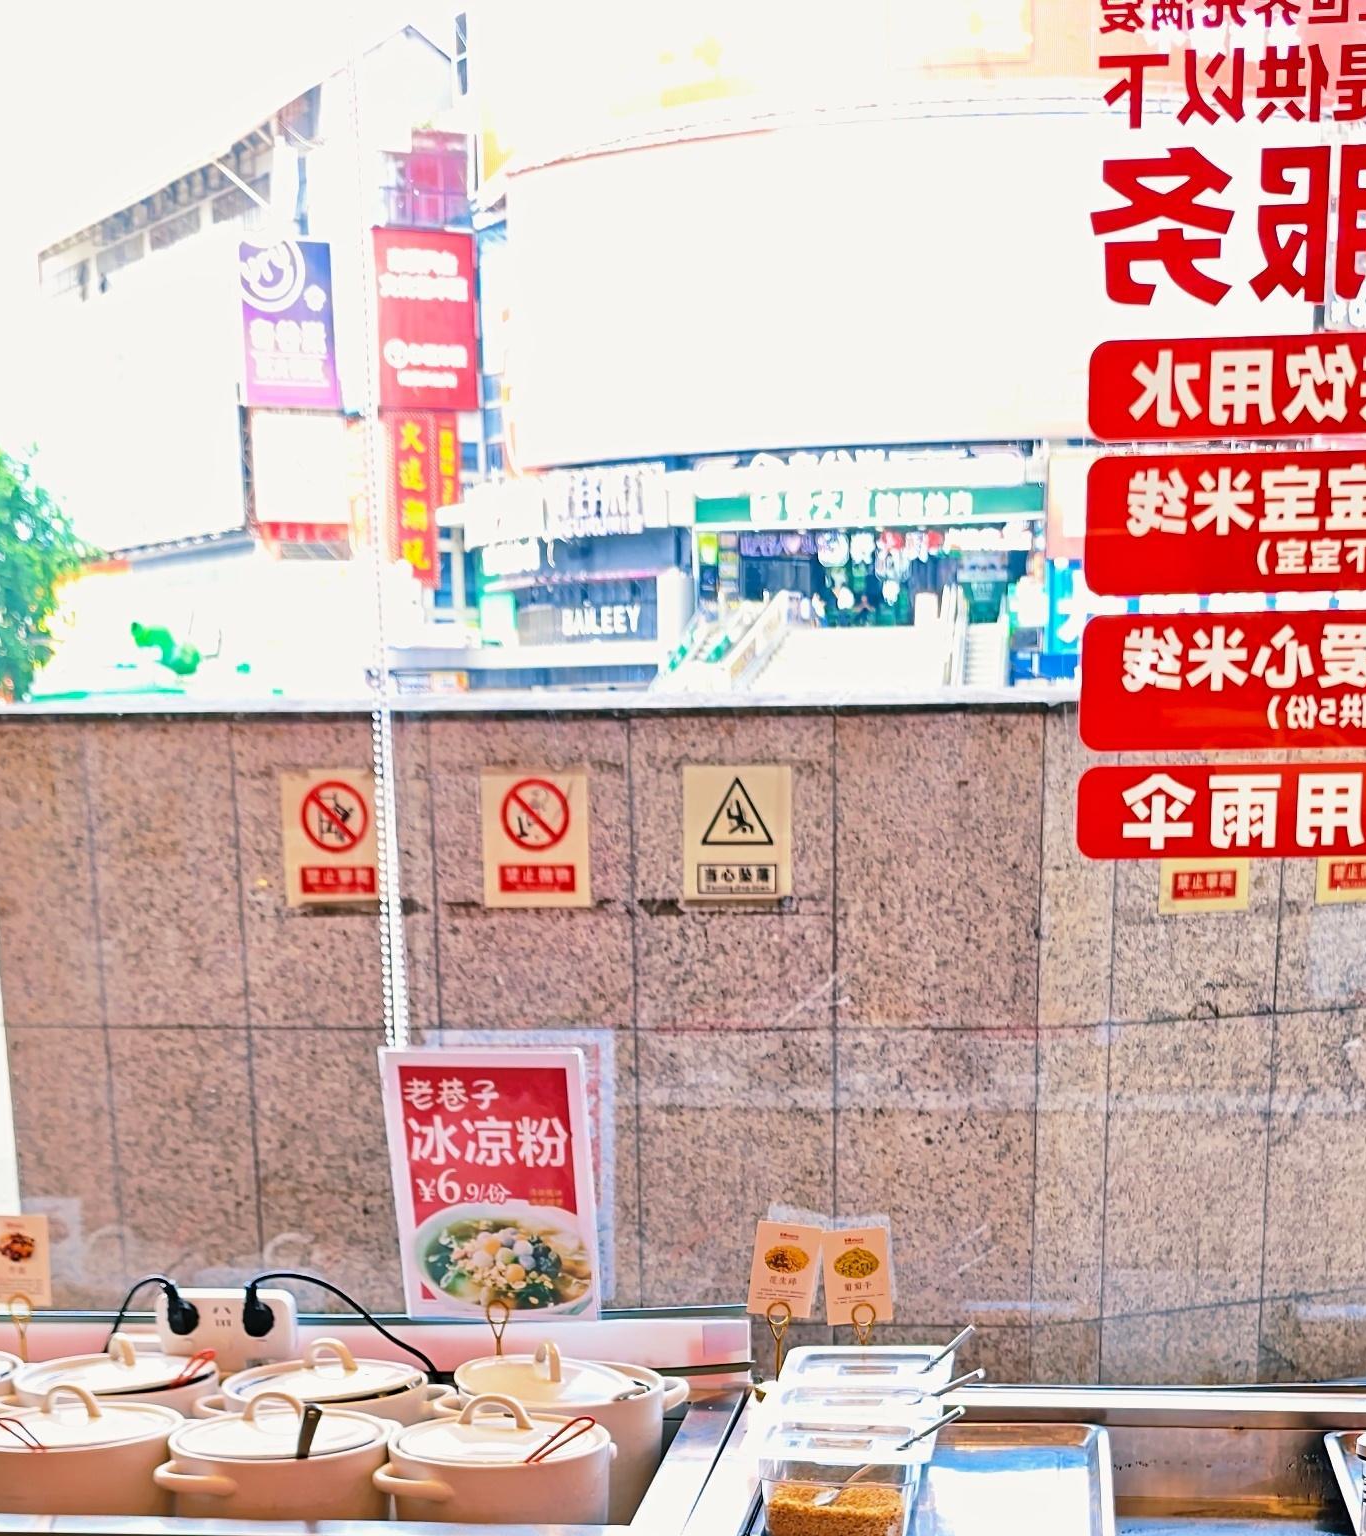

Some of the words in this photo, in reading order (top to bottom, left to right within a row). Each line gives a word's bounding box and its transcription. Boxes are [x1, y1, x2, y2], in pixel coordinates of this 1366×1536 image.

[562, 604, 641, 637] BAILEEY
[403, 1077, 499, 1113] 老巷子
[407, 1115, 569, 1168] 冰凉粉
